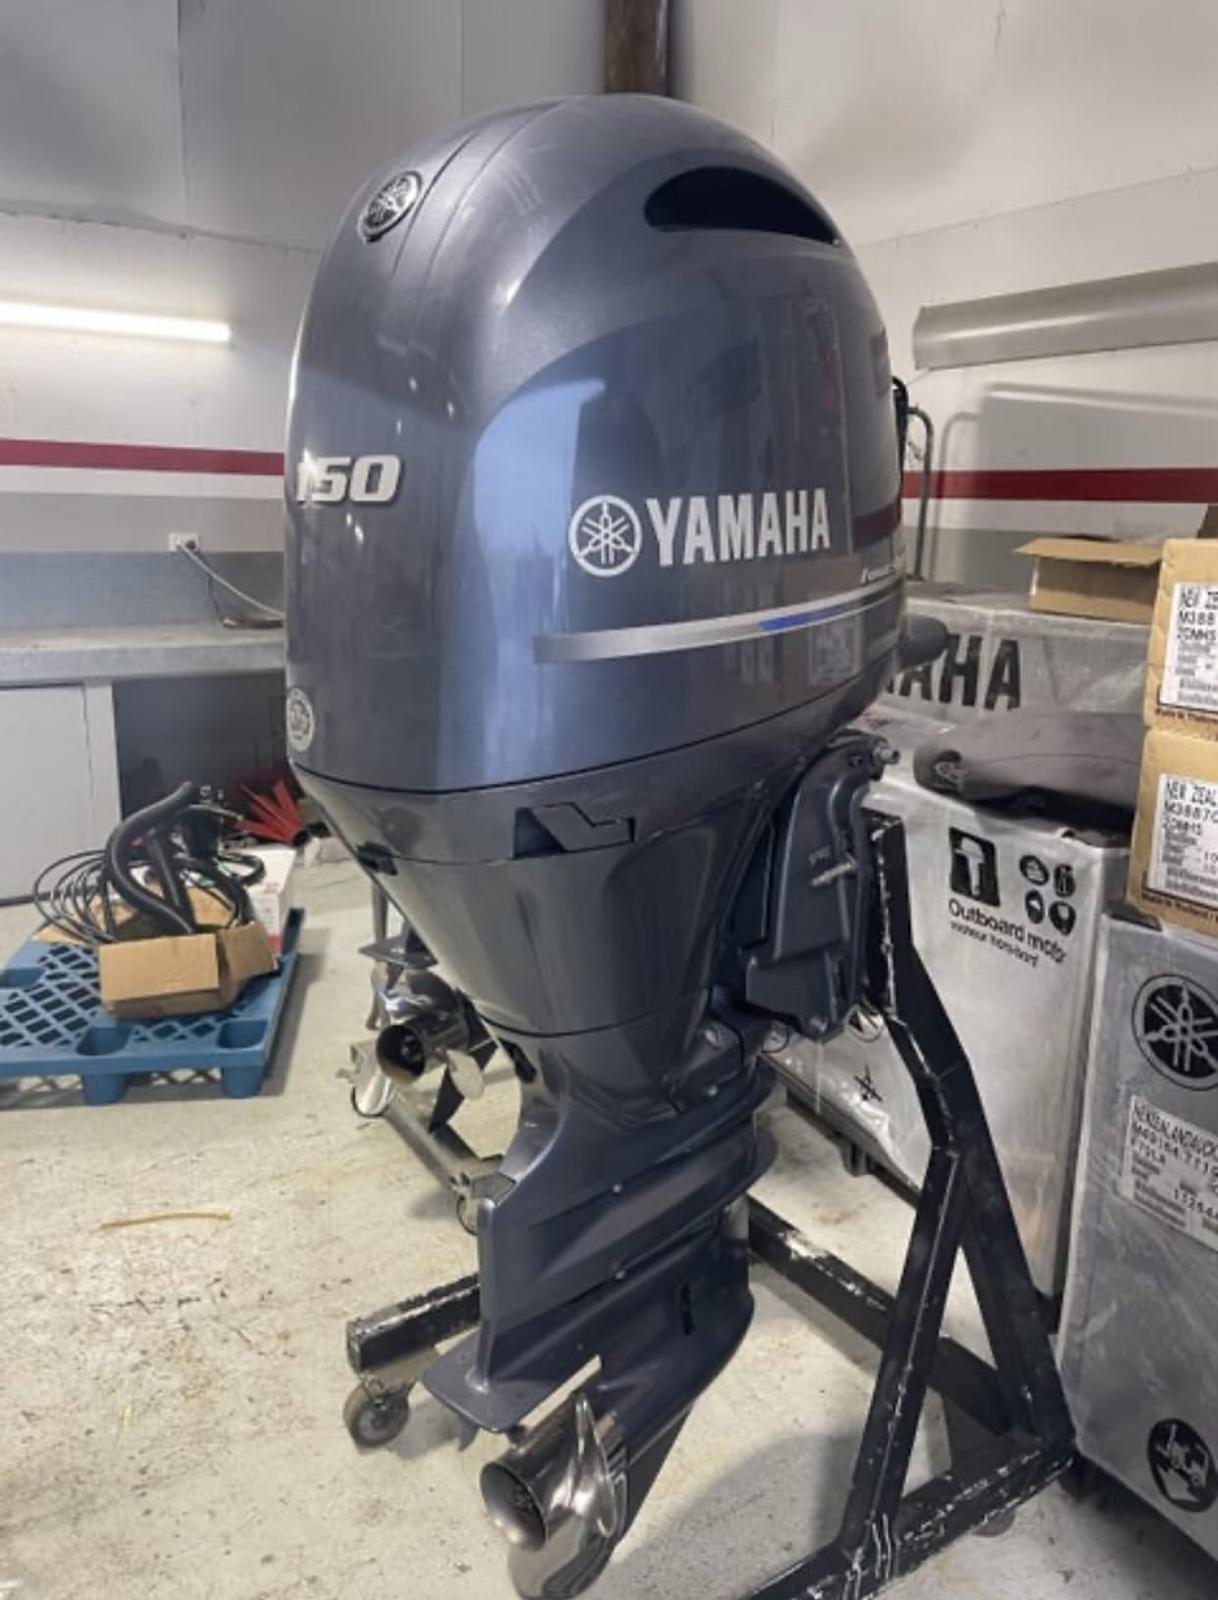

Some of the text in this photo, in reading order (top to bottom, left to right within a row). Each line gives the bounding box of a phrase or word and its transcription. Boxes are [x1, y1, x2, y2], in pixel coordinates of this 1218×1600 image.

[296, 455, 401, 502] 150
[647, 488, 831, 567] YAMAHA
[949, 898, 1067, 963] Outboard motor
